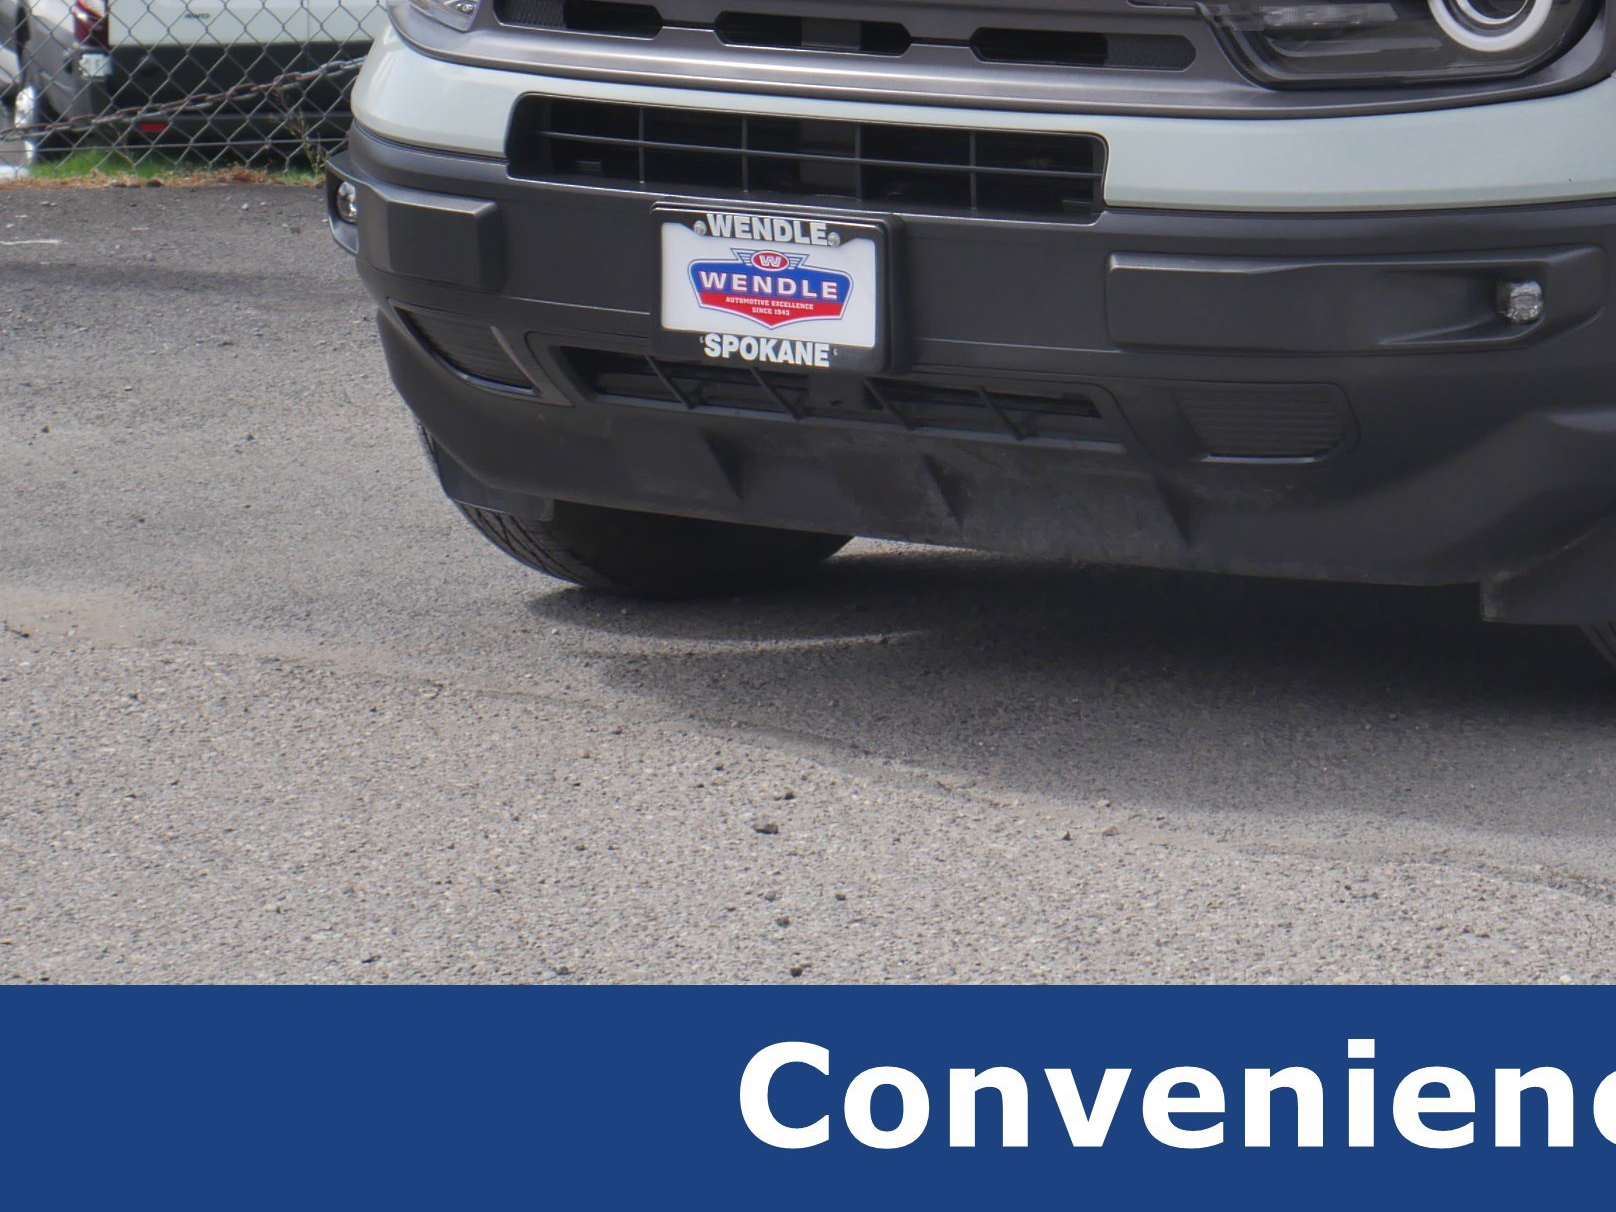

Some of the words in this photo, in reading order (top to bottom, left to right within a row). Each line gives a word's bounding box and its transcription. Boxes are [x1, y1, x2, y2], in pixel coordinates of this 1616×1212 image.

[706, 213, 829, 246] WENDLE
[700, 270, 839, 300] WENDLE
[725, 296, 770, 307] AUTOMOTIVE
[771, 299, 814, 310] EXCELLENCE
[752, 306, 773, 315] SINCE
[774, 308, 790, 316] 1943
[704, 333, 830, 368] SPOKANE
